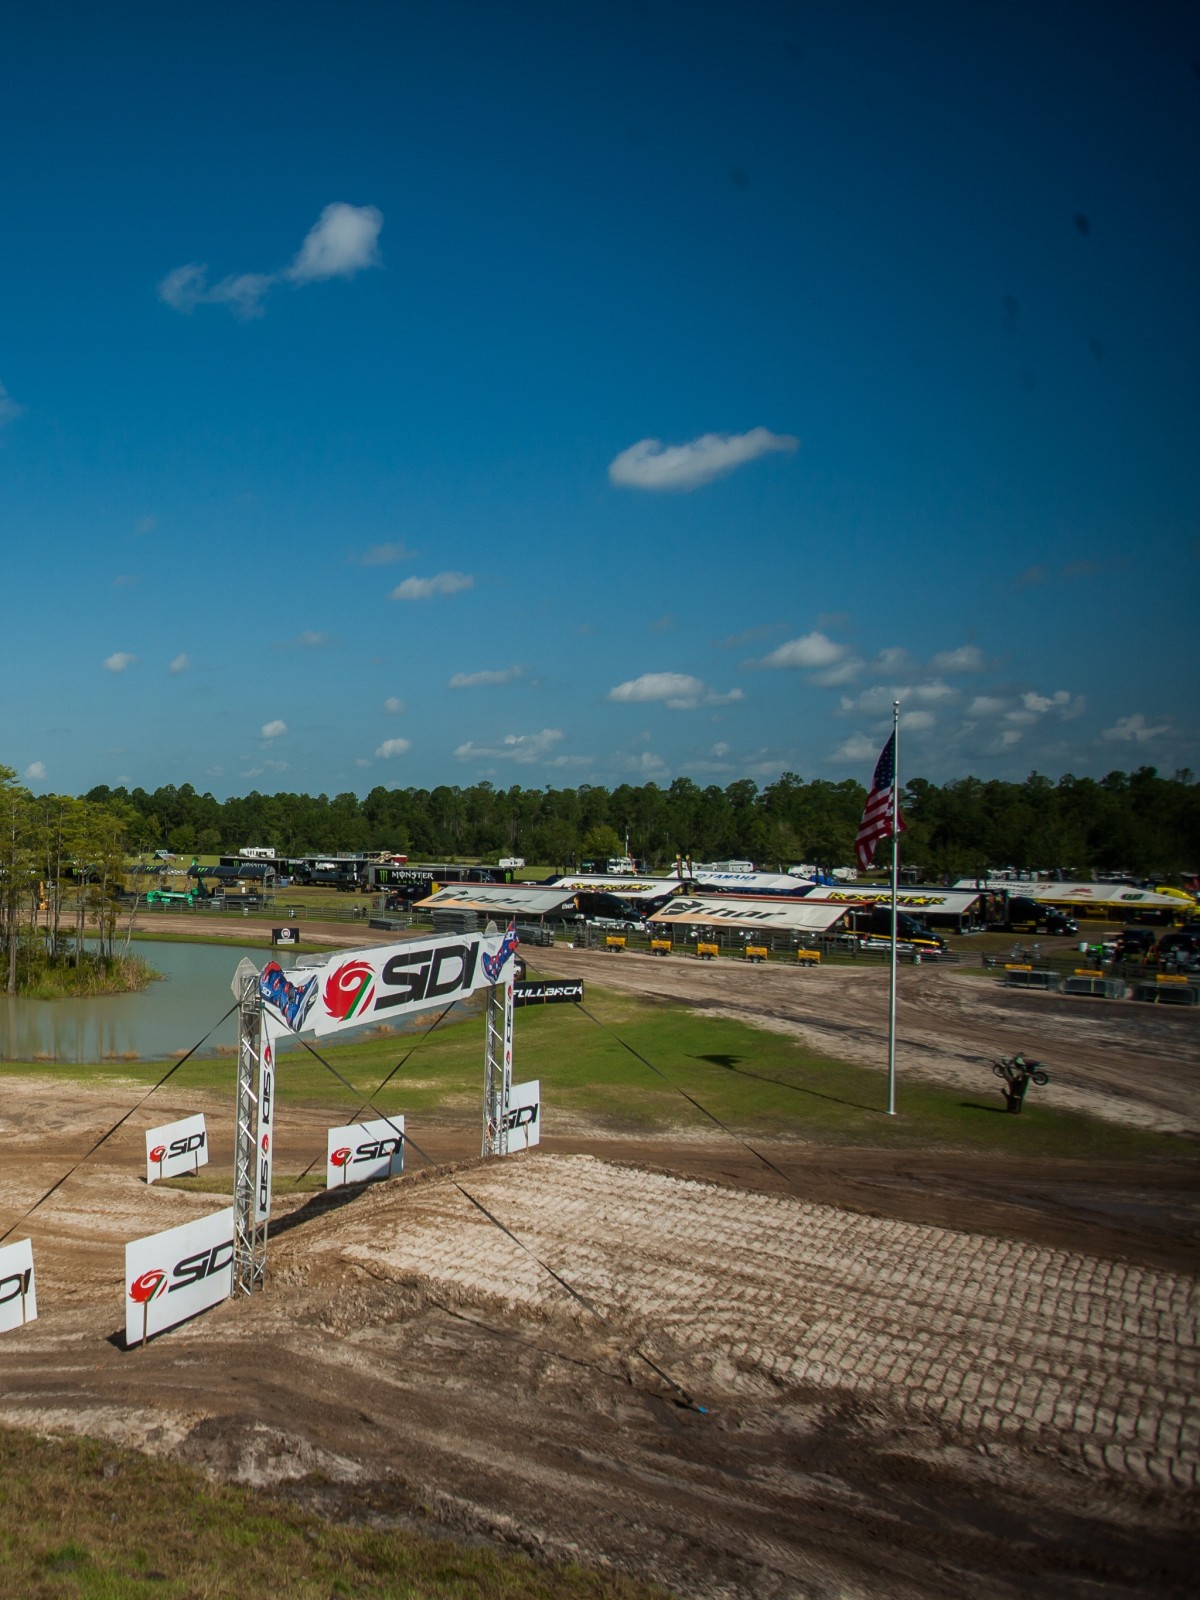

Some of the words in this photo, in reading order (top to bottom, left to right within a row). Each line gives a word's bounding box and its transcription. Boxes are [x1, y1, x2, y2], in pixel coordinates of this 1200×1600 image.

[392, 870, 434, 880] MONSTER
[709, 873, 757, 881] YAMAHA
[374, 941, 480, 1011] SIDI
[512, 986, 583, 998] FULLBACK
[262, 1070, 271, 1125] SIDI
[168, 1131, 205, 1159] SIDI
[353, 1136, 403, 1164] SIDI
[259, 1158, 269, 1213] SIDI
[168, 1239, 234, 1293] SID
